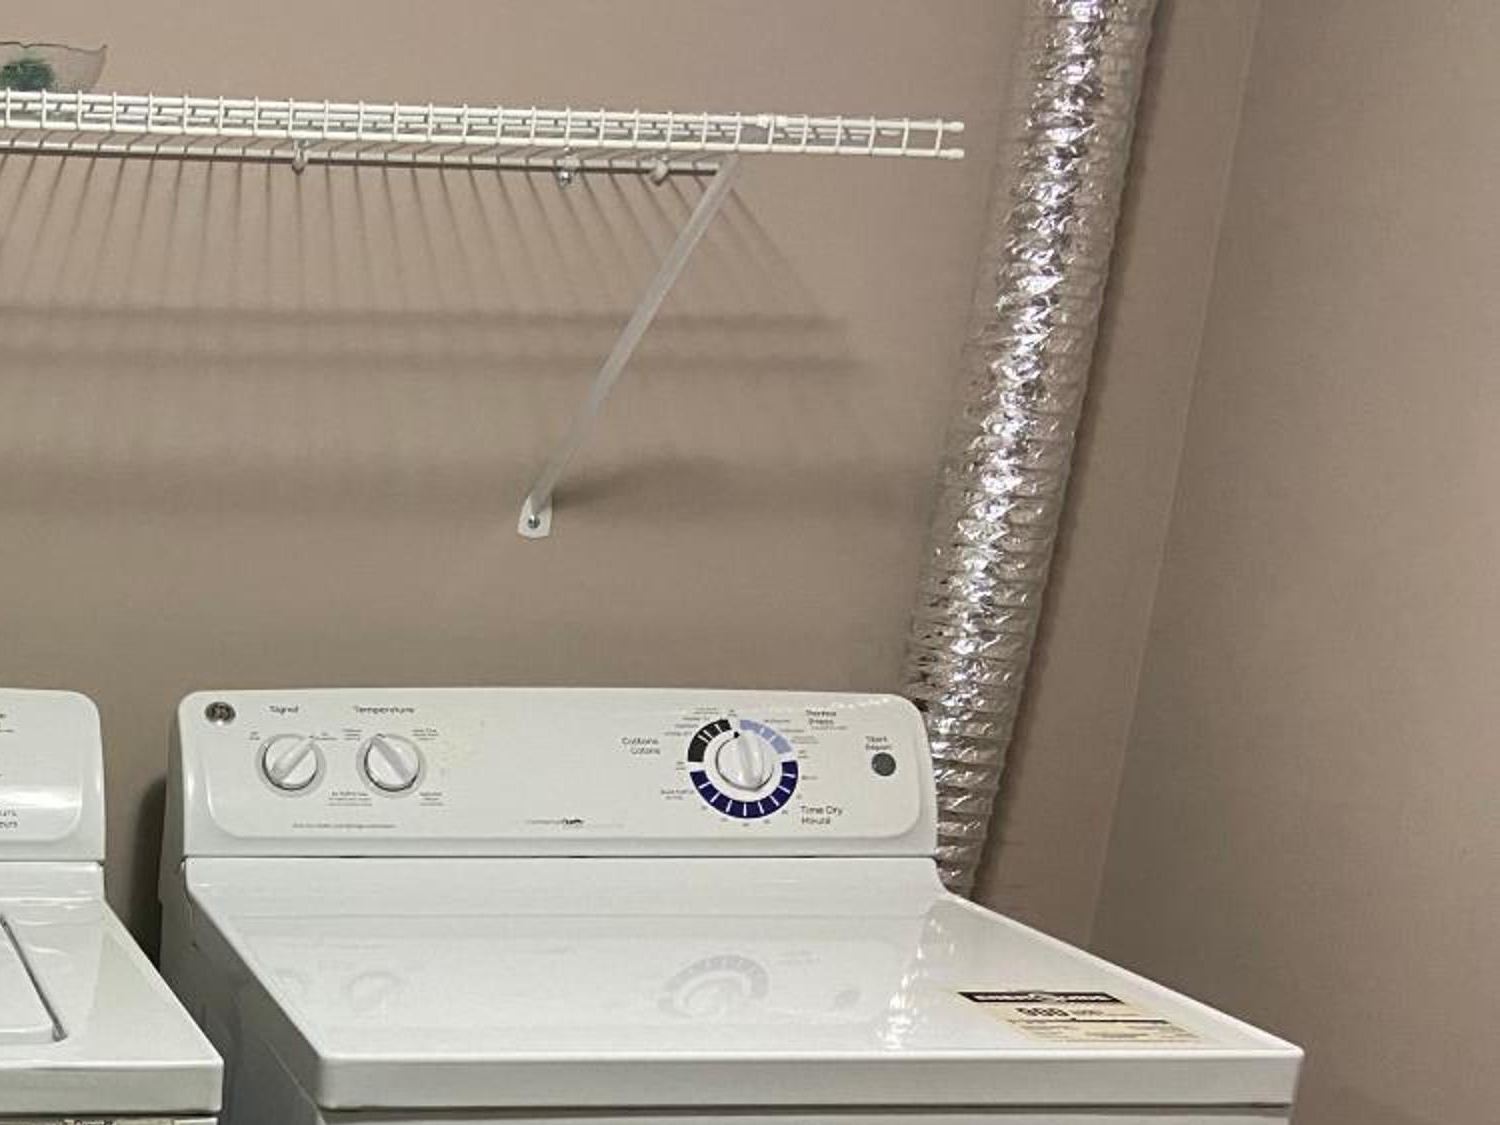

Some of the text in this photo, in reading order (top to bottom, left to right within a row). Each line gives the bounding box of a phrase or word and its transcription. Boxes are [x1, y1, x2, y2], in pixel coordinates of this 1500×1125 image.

[352, 704, 415, 714] Temperature
[621, 736, 659, 745] Cottons
[800, 805, 843, 817] Time Dry
